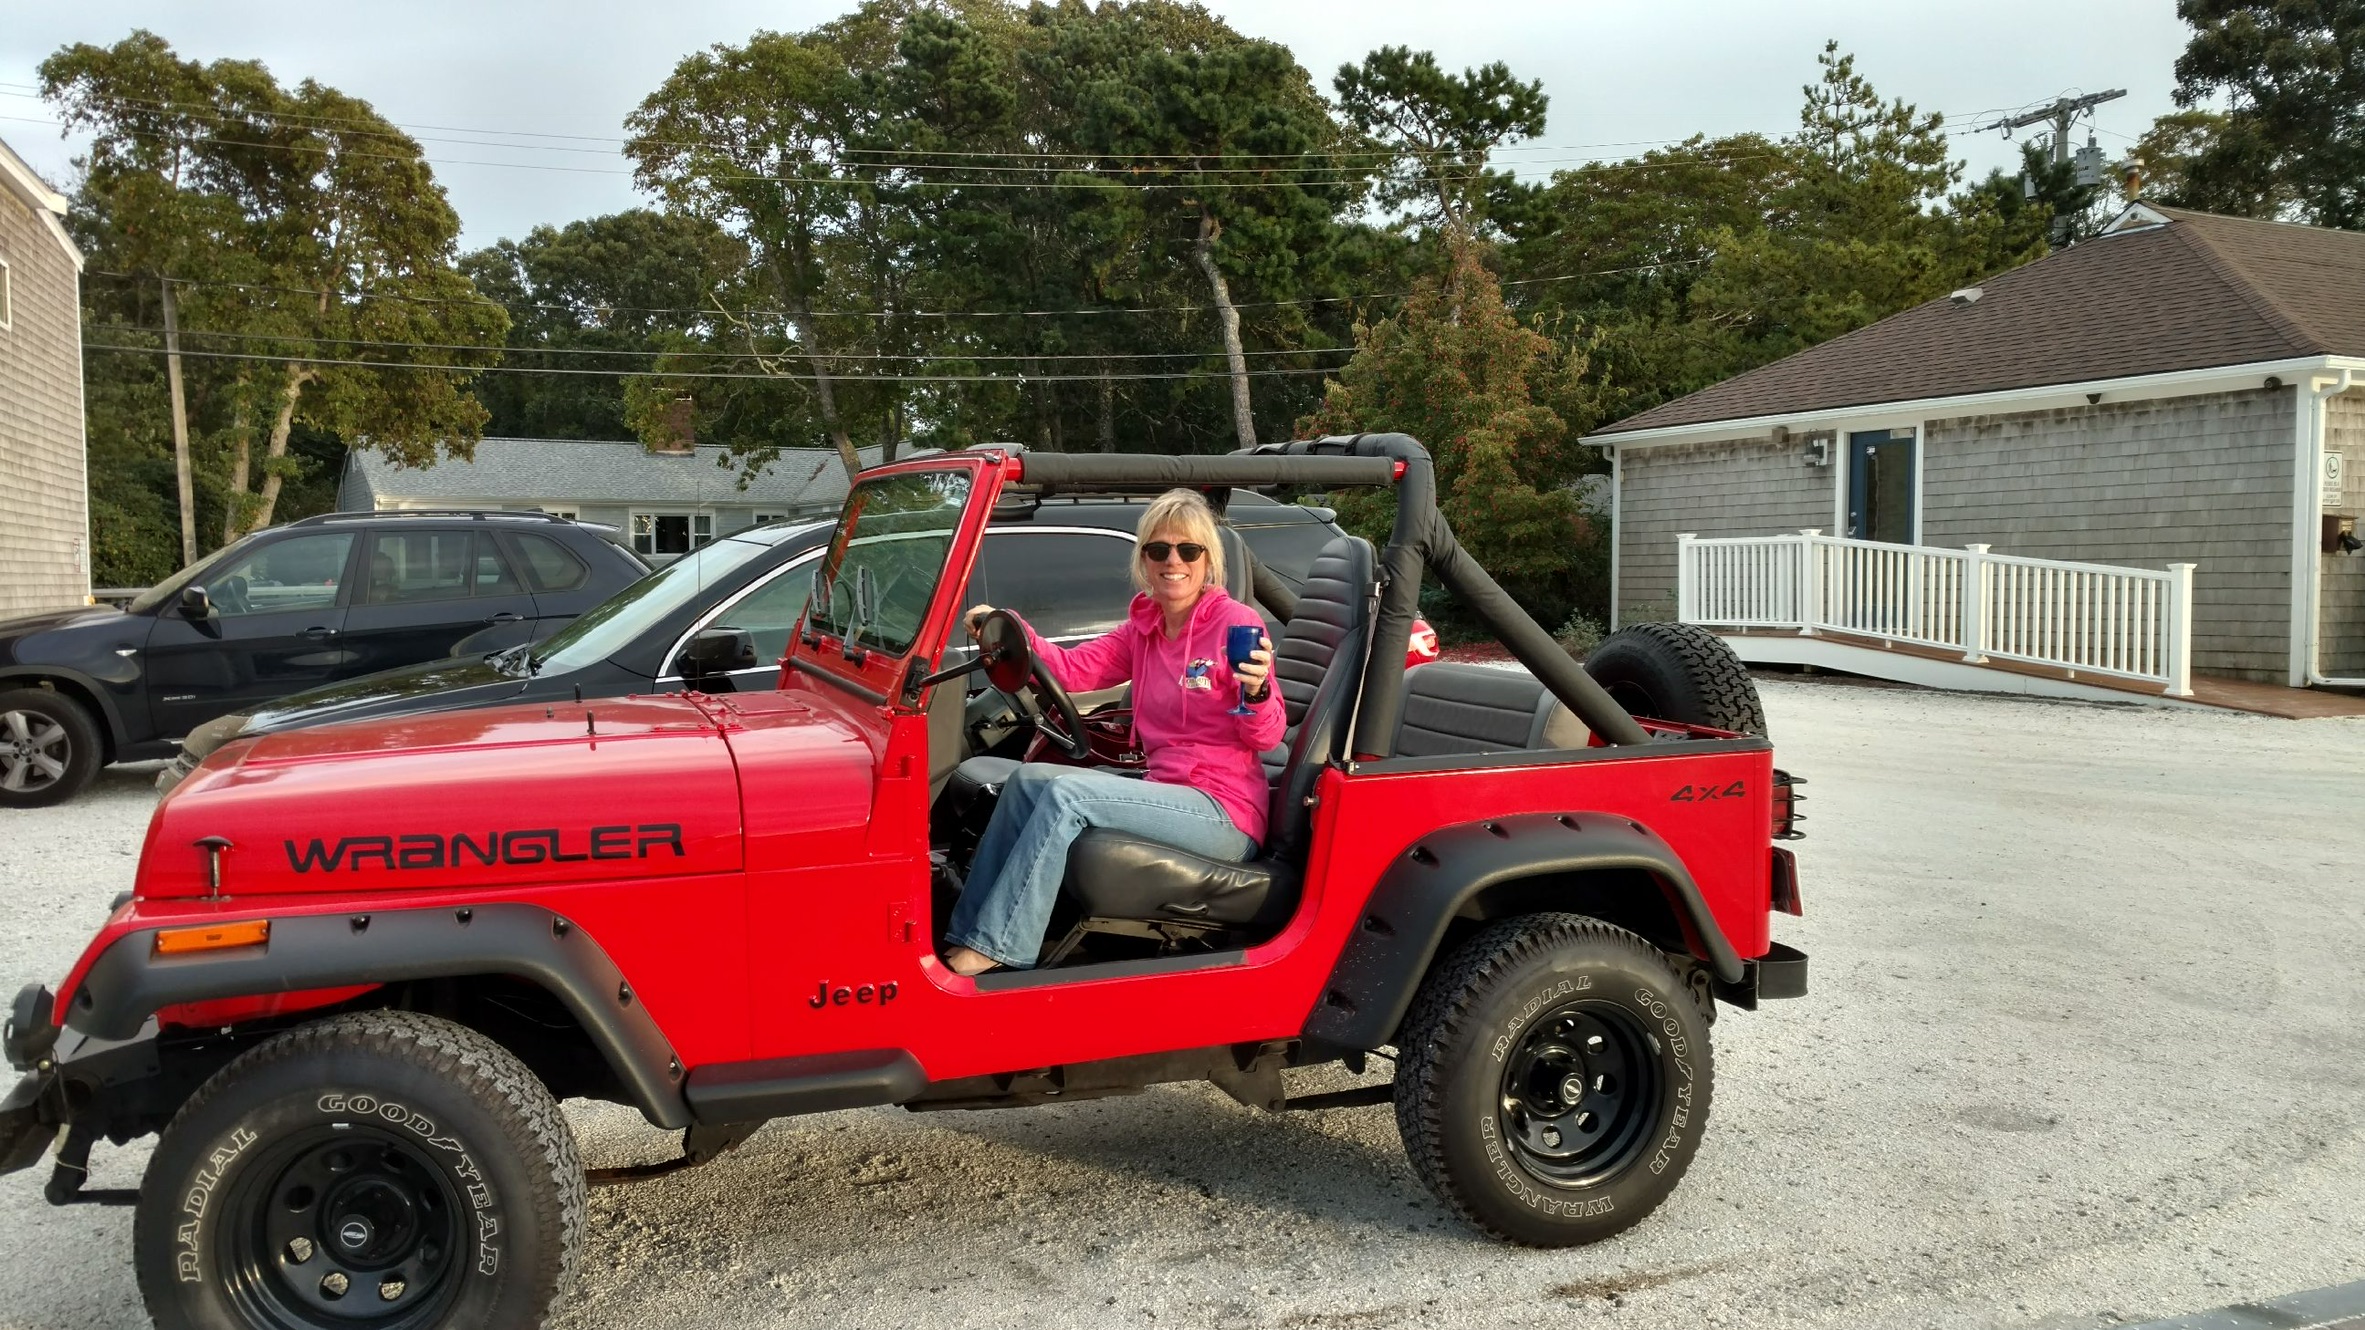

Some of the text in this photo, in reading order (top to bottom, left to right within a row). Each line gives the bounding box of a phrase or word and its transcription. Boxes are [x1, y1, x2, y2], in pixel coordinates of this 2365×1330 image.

[808, 979, 898, 1009] Jeep
[1491, 975, 1593, 1062] RADIAL
[177, 1127, 258, 1283] RADIAL
[1480, 1116, 1615, 1218] WRANGLER
